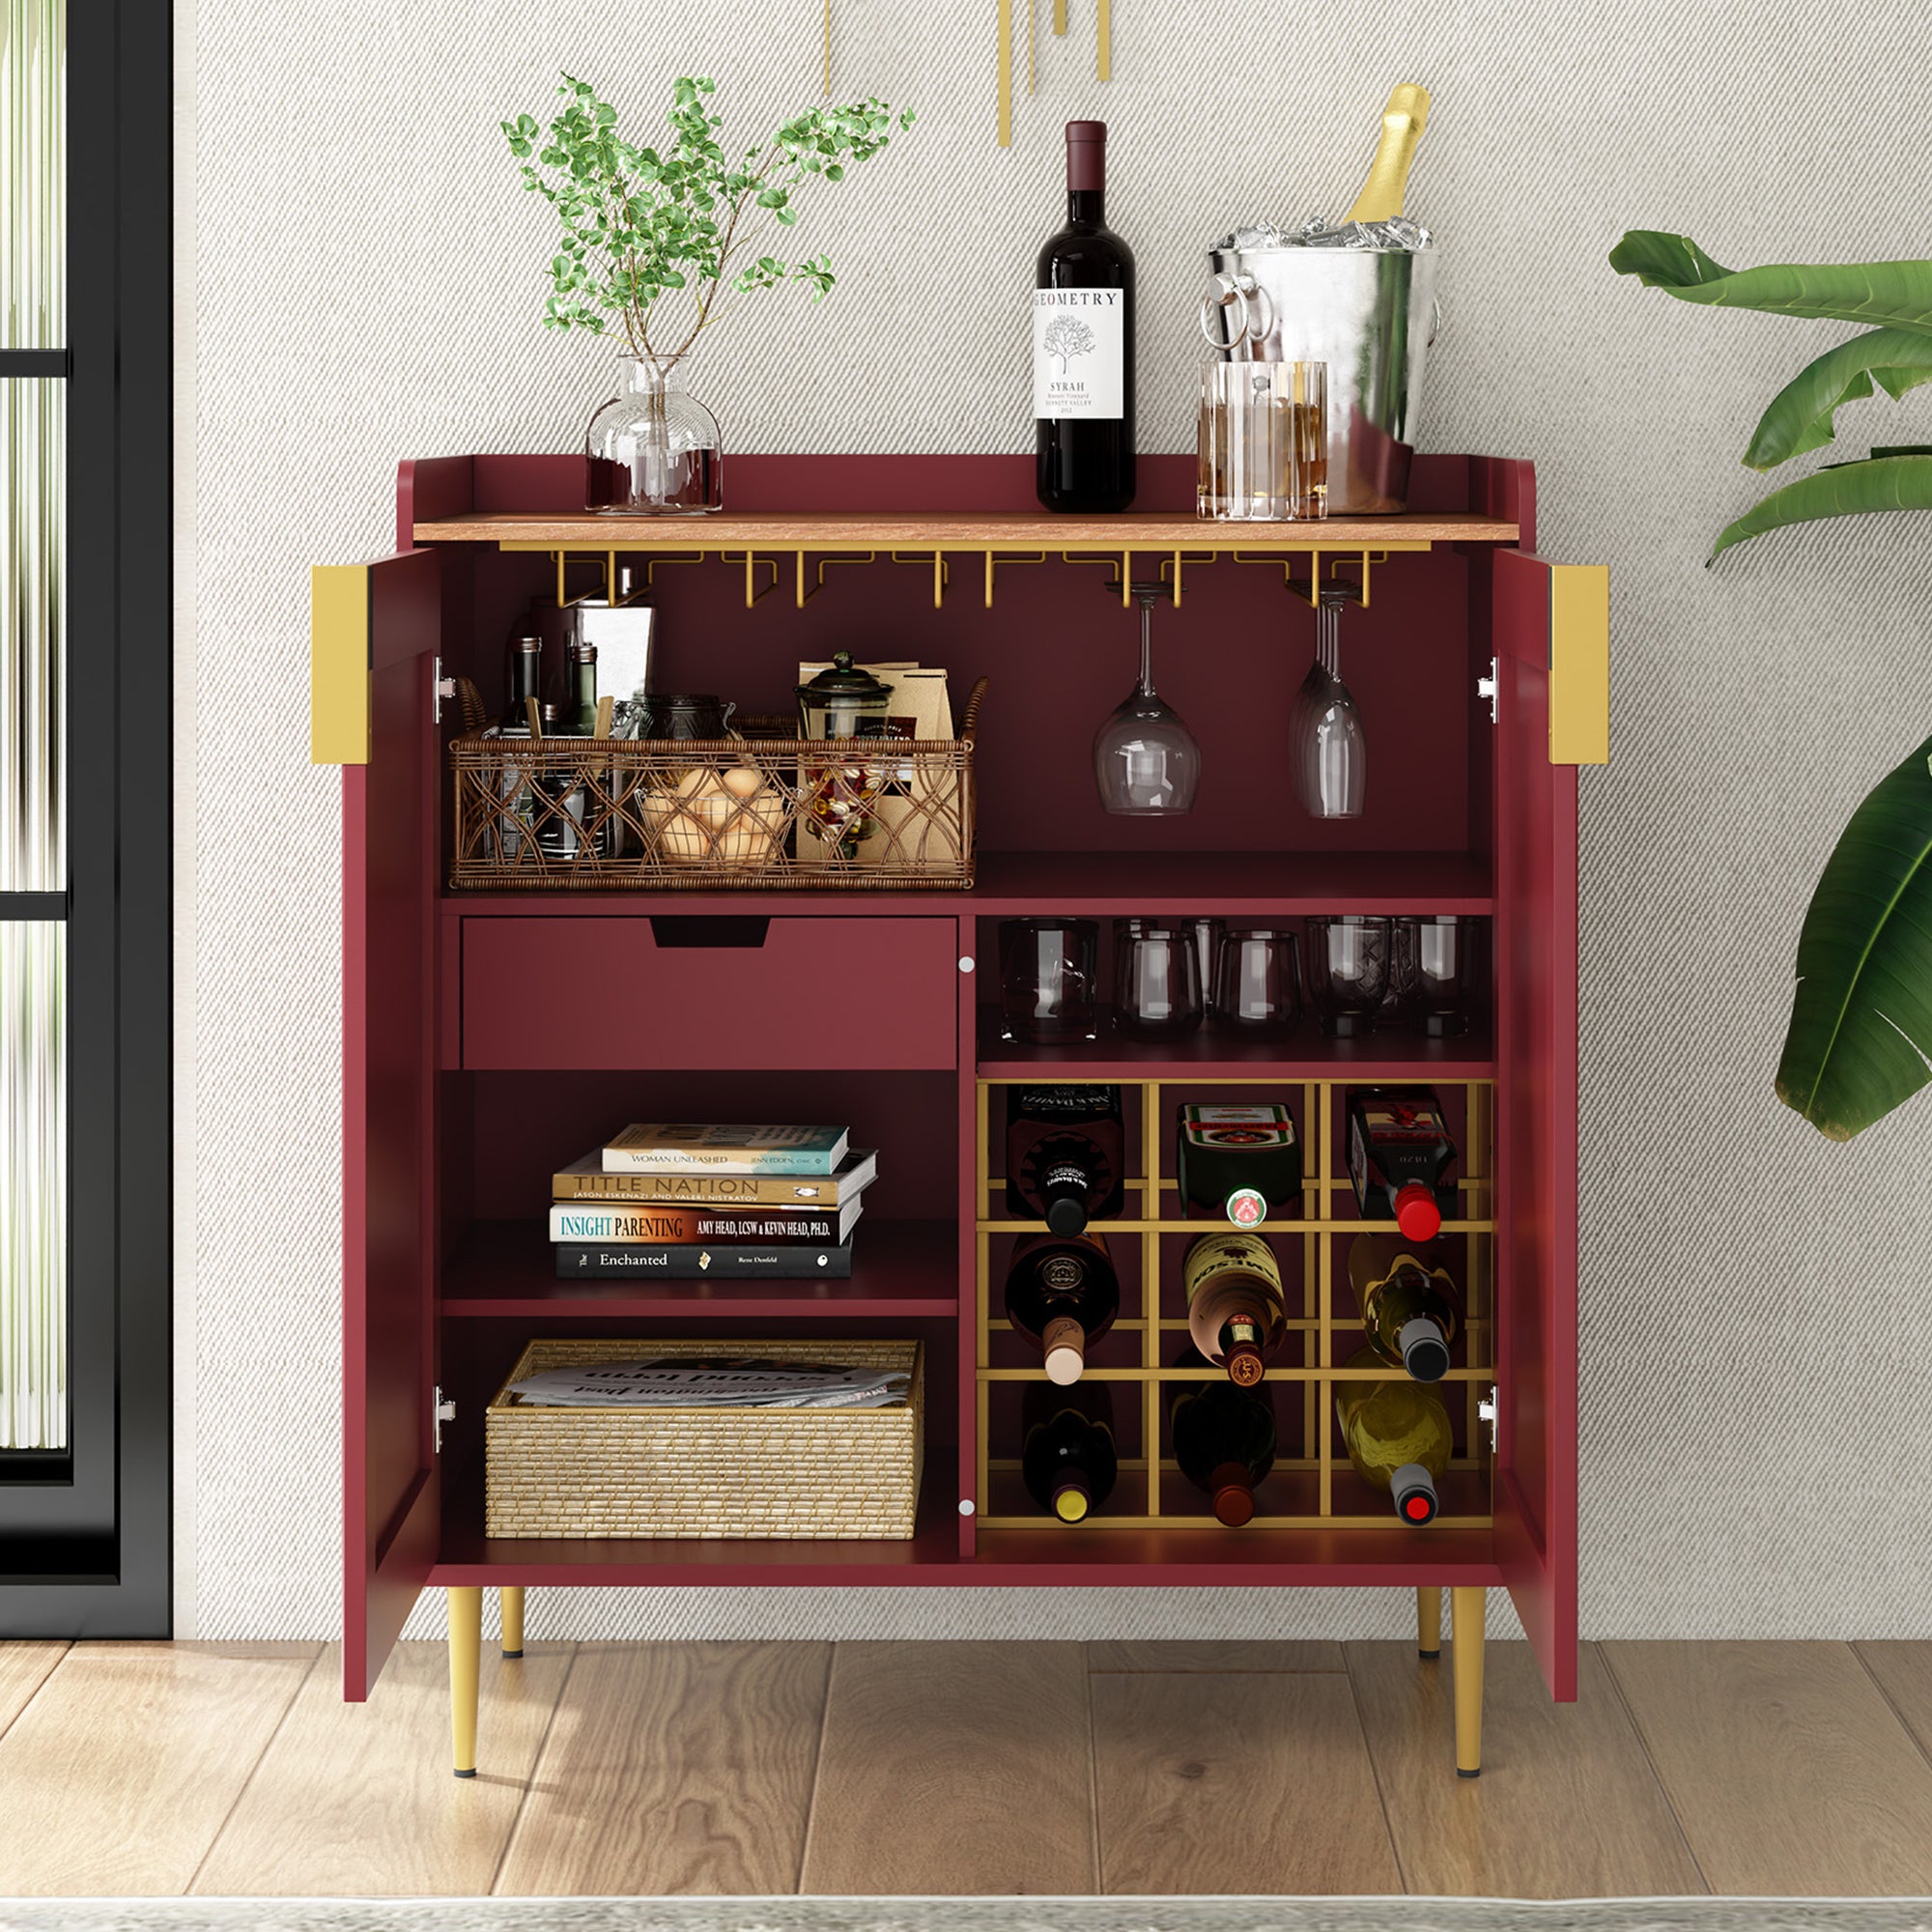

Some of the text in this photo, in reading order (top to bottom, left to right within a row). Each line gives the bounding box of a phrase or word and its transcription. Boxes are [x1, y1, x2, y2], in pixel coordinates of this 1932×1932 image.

[1050, 382, 1085, 392] SYRAH
[631, 1154, 728, 1164] WOMAN UNLEASHED
[573, 1176, 759, 1195] TITLE NATION
[573, 1191, 603, 1200] JASON
[605, 1191, 649, 1200] ESKENAZI
[707, 1194, 758, 1203] NISTRATOV
[560, 1216, 831, 1238] INSIGHT PARENTING AMY HEAD, LCSW & KEVIN HEAD, PH.D.
[599, 1253, 668, 1265] Enchanted
